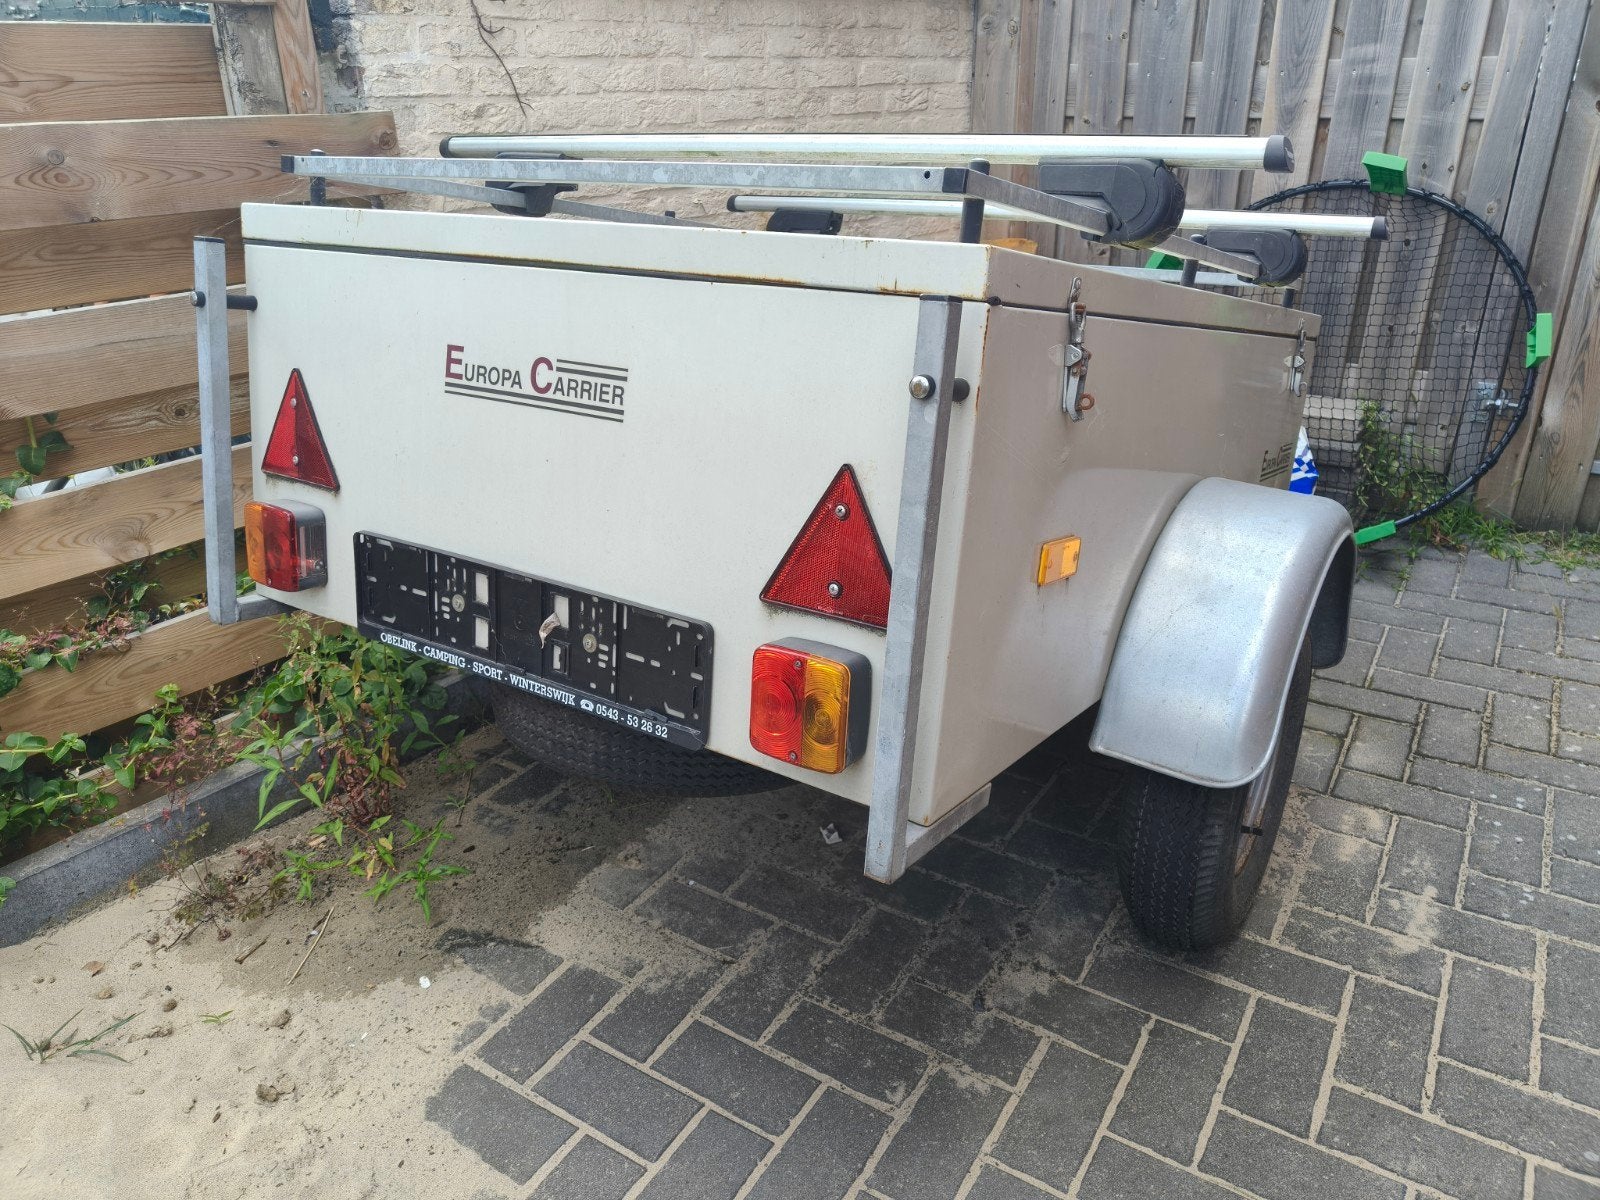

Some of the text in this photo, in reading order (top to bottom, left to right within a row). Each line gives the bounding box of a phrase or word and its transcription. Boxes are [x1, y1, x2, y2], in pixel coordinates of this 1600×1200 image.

[445, 344, 625, 406] EUROPA CARRIER
[380, 632, 418, 653] OBELINK
[423, 645, 466, 669] CAMPING
[472, 661, 503, 681] SPORT
[509, 673, 576, 706] WINTERSWIJK
[595, 704, 619, 721] 0543
[626, 714, 639, 728] 53
[641, 719, 653, 733] 26
[655, 724, 668, 739] 32
